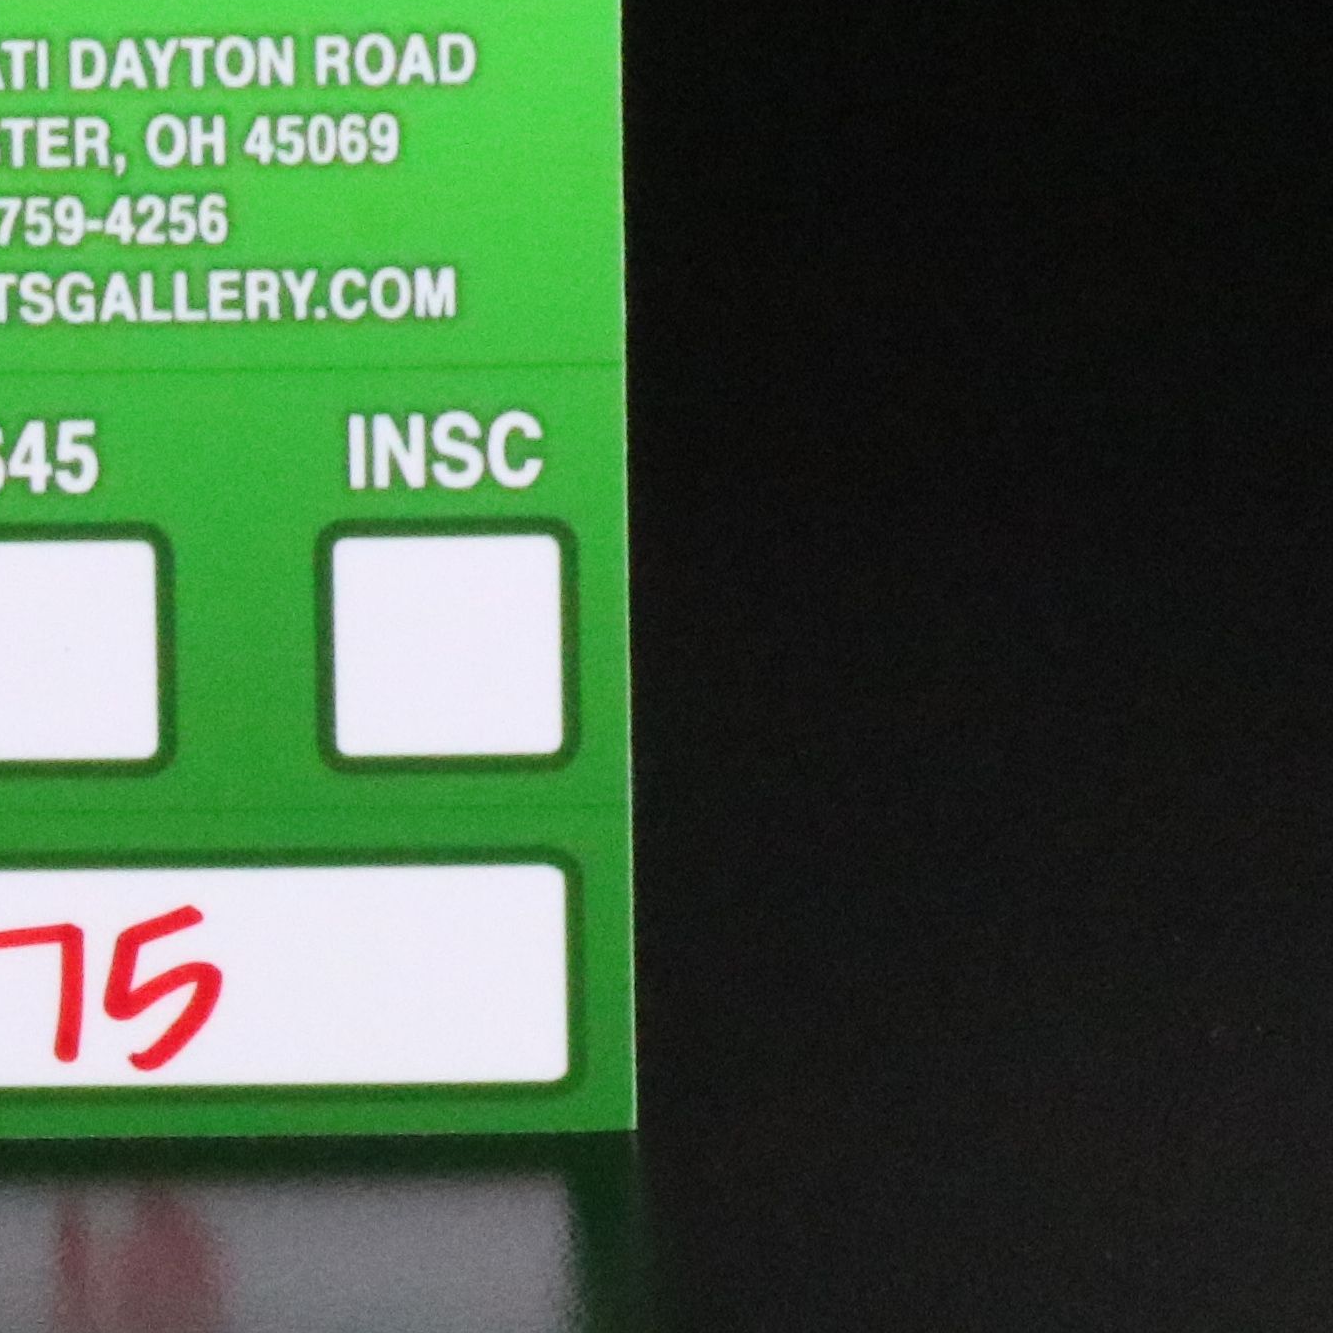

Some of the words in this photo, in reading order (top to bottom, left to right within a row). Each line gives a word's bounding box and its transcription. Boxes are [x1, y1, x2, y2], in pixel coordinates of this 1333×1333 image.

[70, 36, 294, 89] DAYTON
[316, 34, 475, 86] ROAD
[146, 115, 225, 167] OH
[244, 114, 398, 164] 45069
[349, 411, 542, 488] INSC
